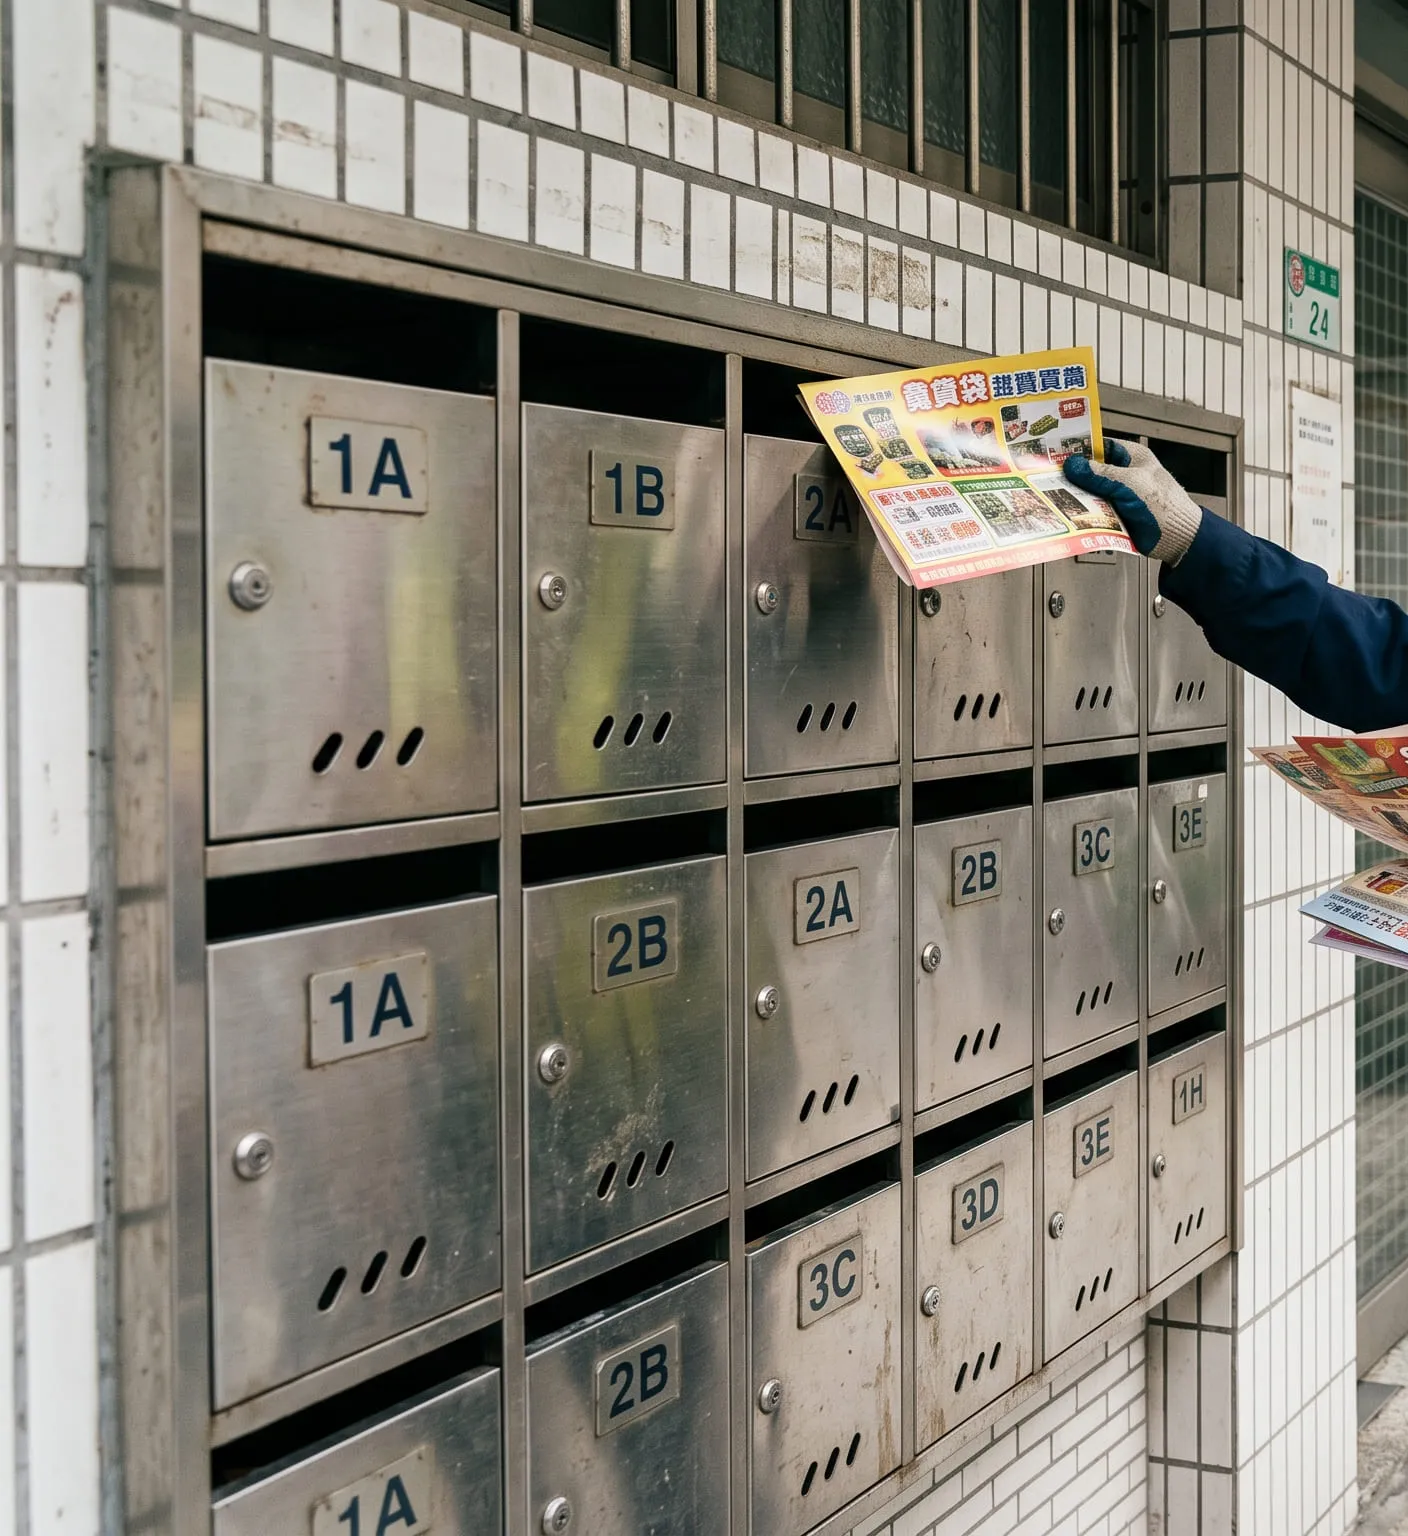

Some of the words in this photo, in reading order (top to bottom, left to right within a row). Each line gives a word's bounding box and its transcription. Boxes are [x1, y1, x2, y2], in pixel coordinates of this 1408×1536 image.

[1309, 301, 1329, 340] 24
[328, 433, 412, 499] 1A
[606, 463, 664, 516] 1B
[805, 485, 853, 534] 2A
[1080, 827, 1110, 867] 3C
[1180, 807, 1201, 842] 3E
[962, 851, 996, 896] 2B
[806, 881, 853, 932] 2A
[608, 915, 667, 977] 2B
[330, 973, 413, 1043] 1A
[1180, 1074, 1202, 1113] 1H
[1082, 1118, 1109, 1165] 3E
[962, 1178, 998, 1230] 3D
[810, 1249, 856, 1311] 3C
[610, 1344, 668, 1419] 2B
[339, 1475, 417, 1536] 1A
